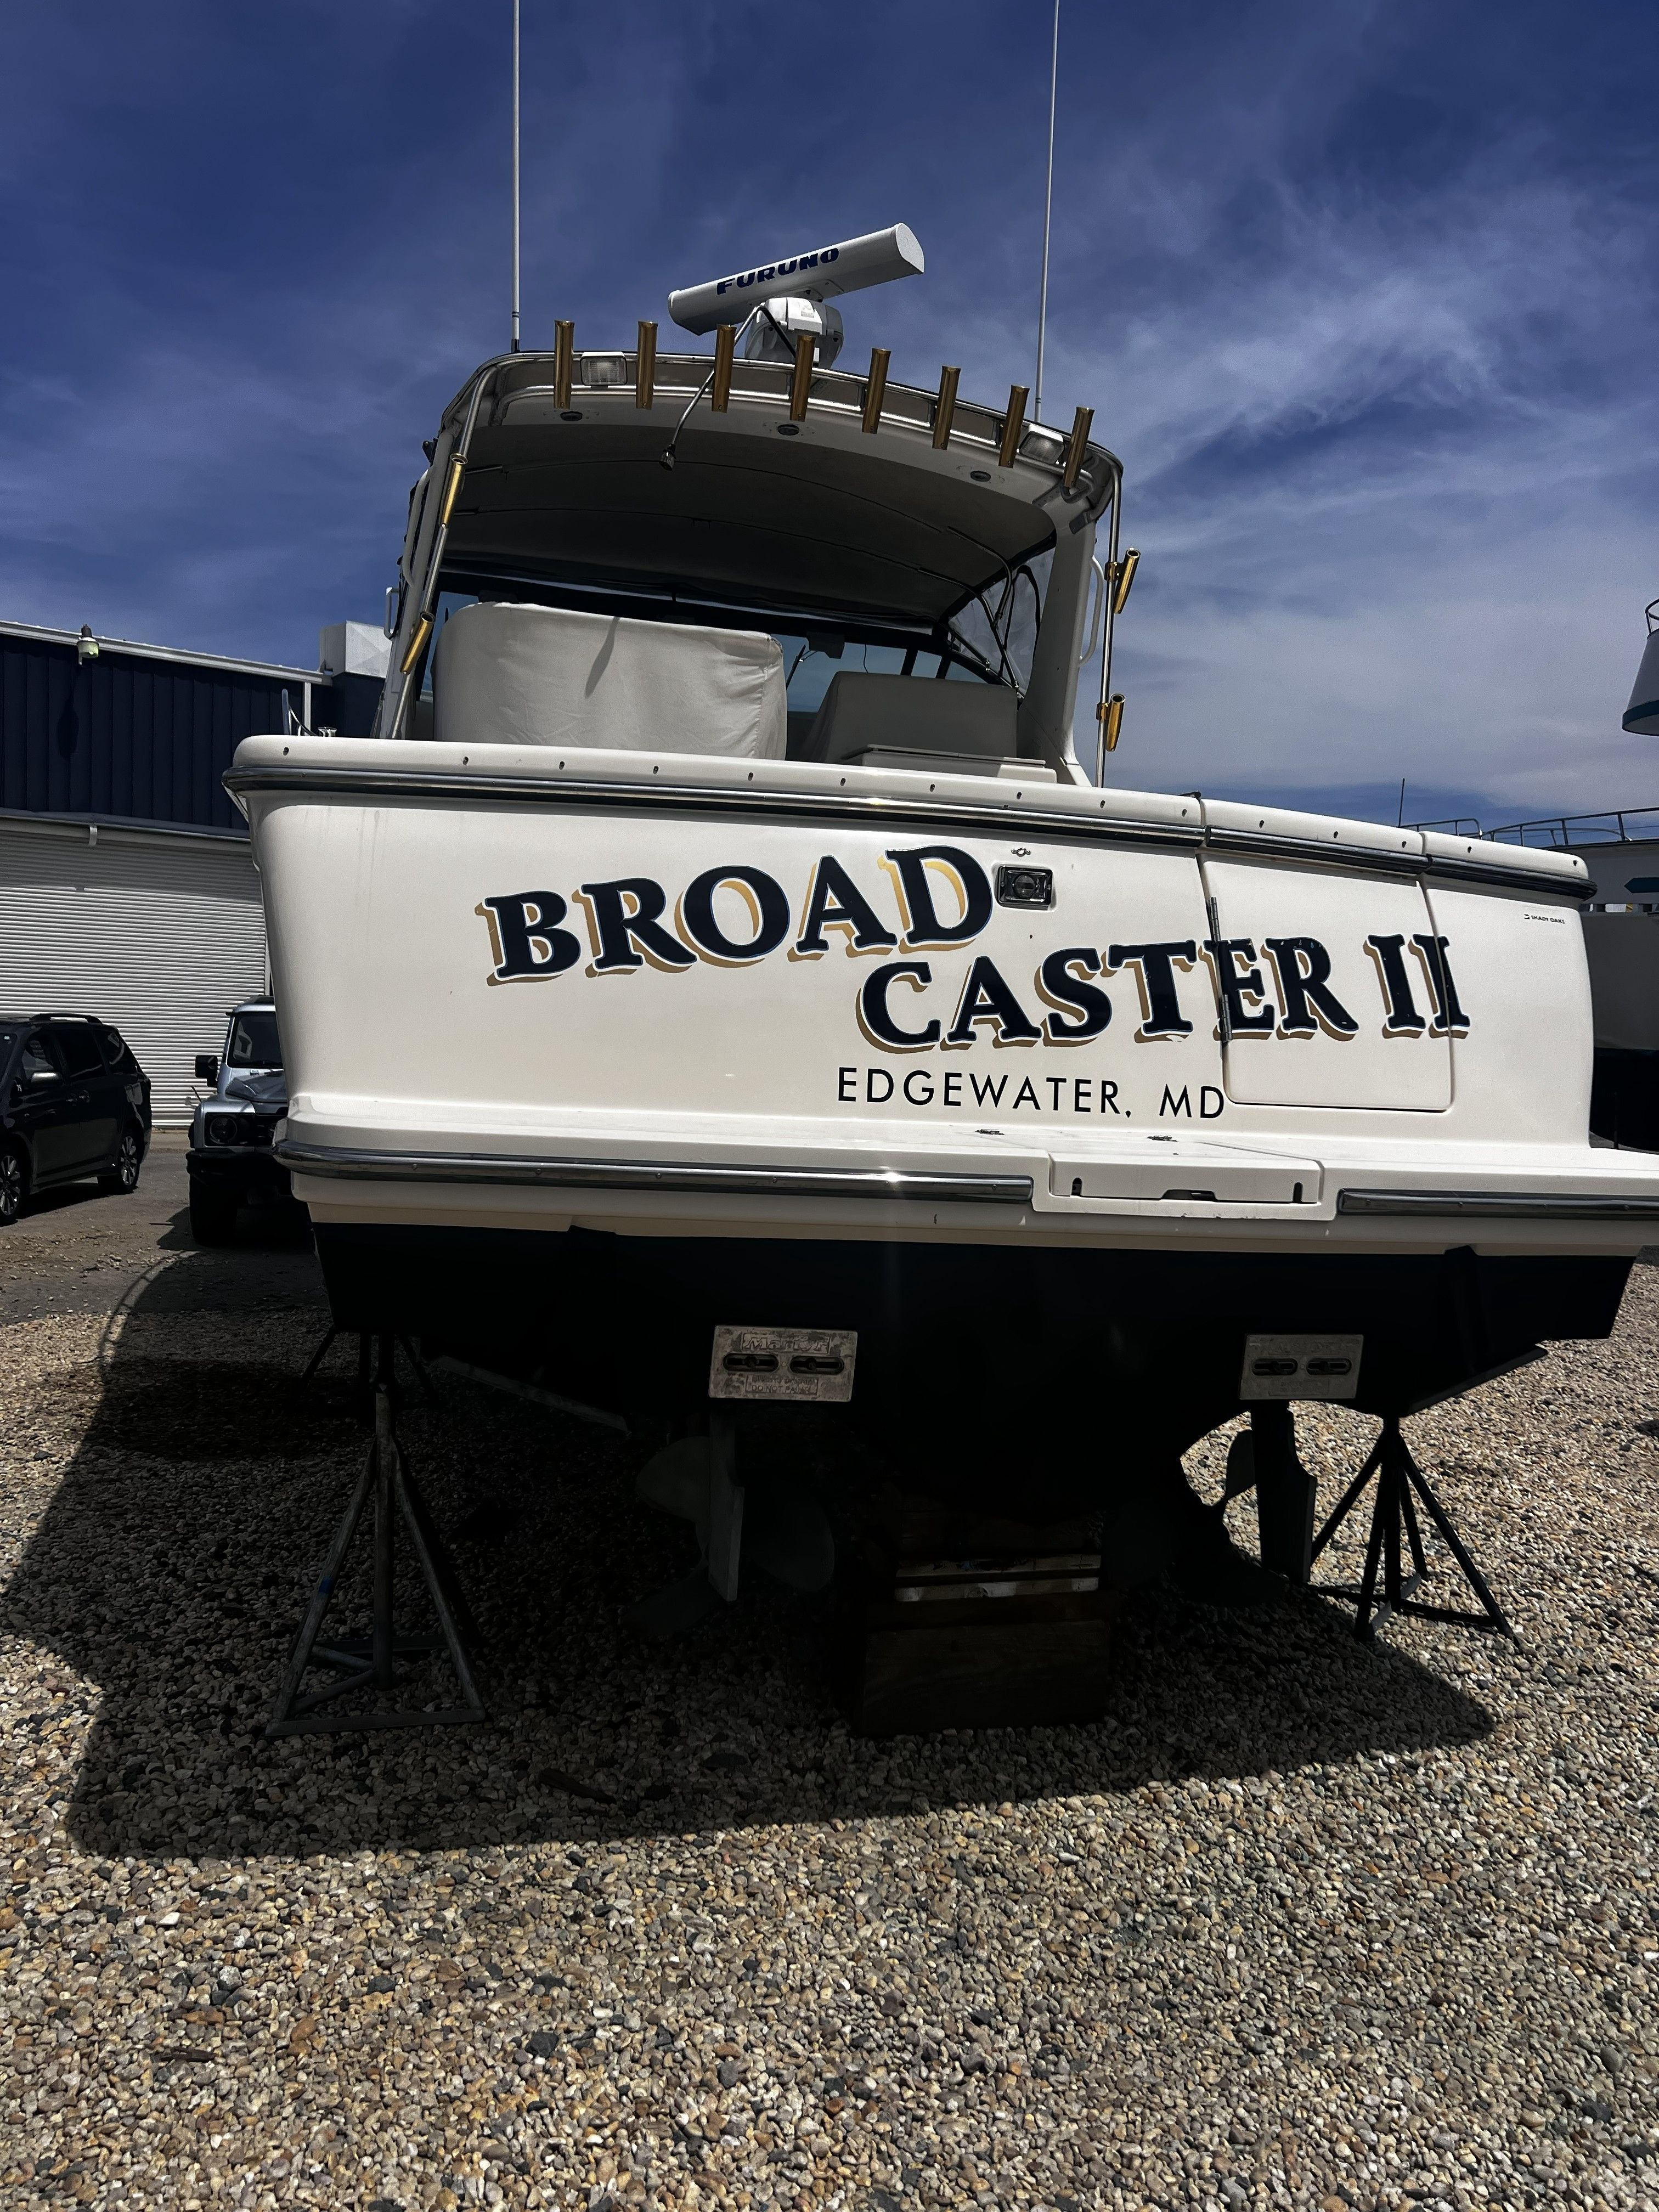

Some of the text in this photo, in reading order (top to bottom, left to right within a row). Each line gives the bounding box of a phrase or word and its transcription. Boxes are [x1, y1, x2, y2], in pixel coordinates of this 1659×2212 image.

[716, 247, 839, 295] FURUNO
[475, 845, 992, 986] BROAD
[855, 934, 1471, 1054] CASTER II
[1159, 1084, 1224, 1119] MD
